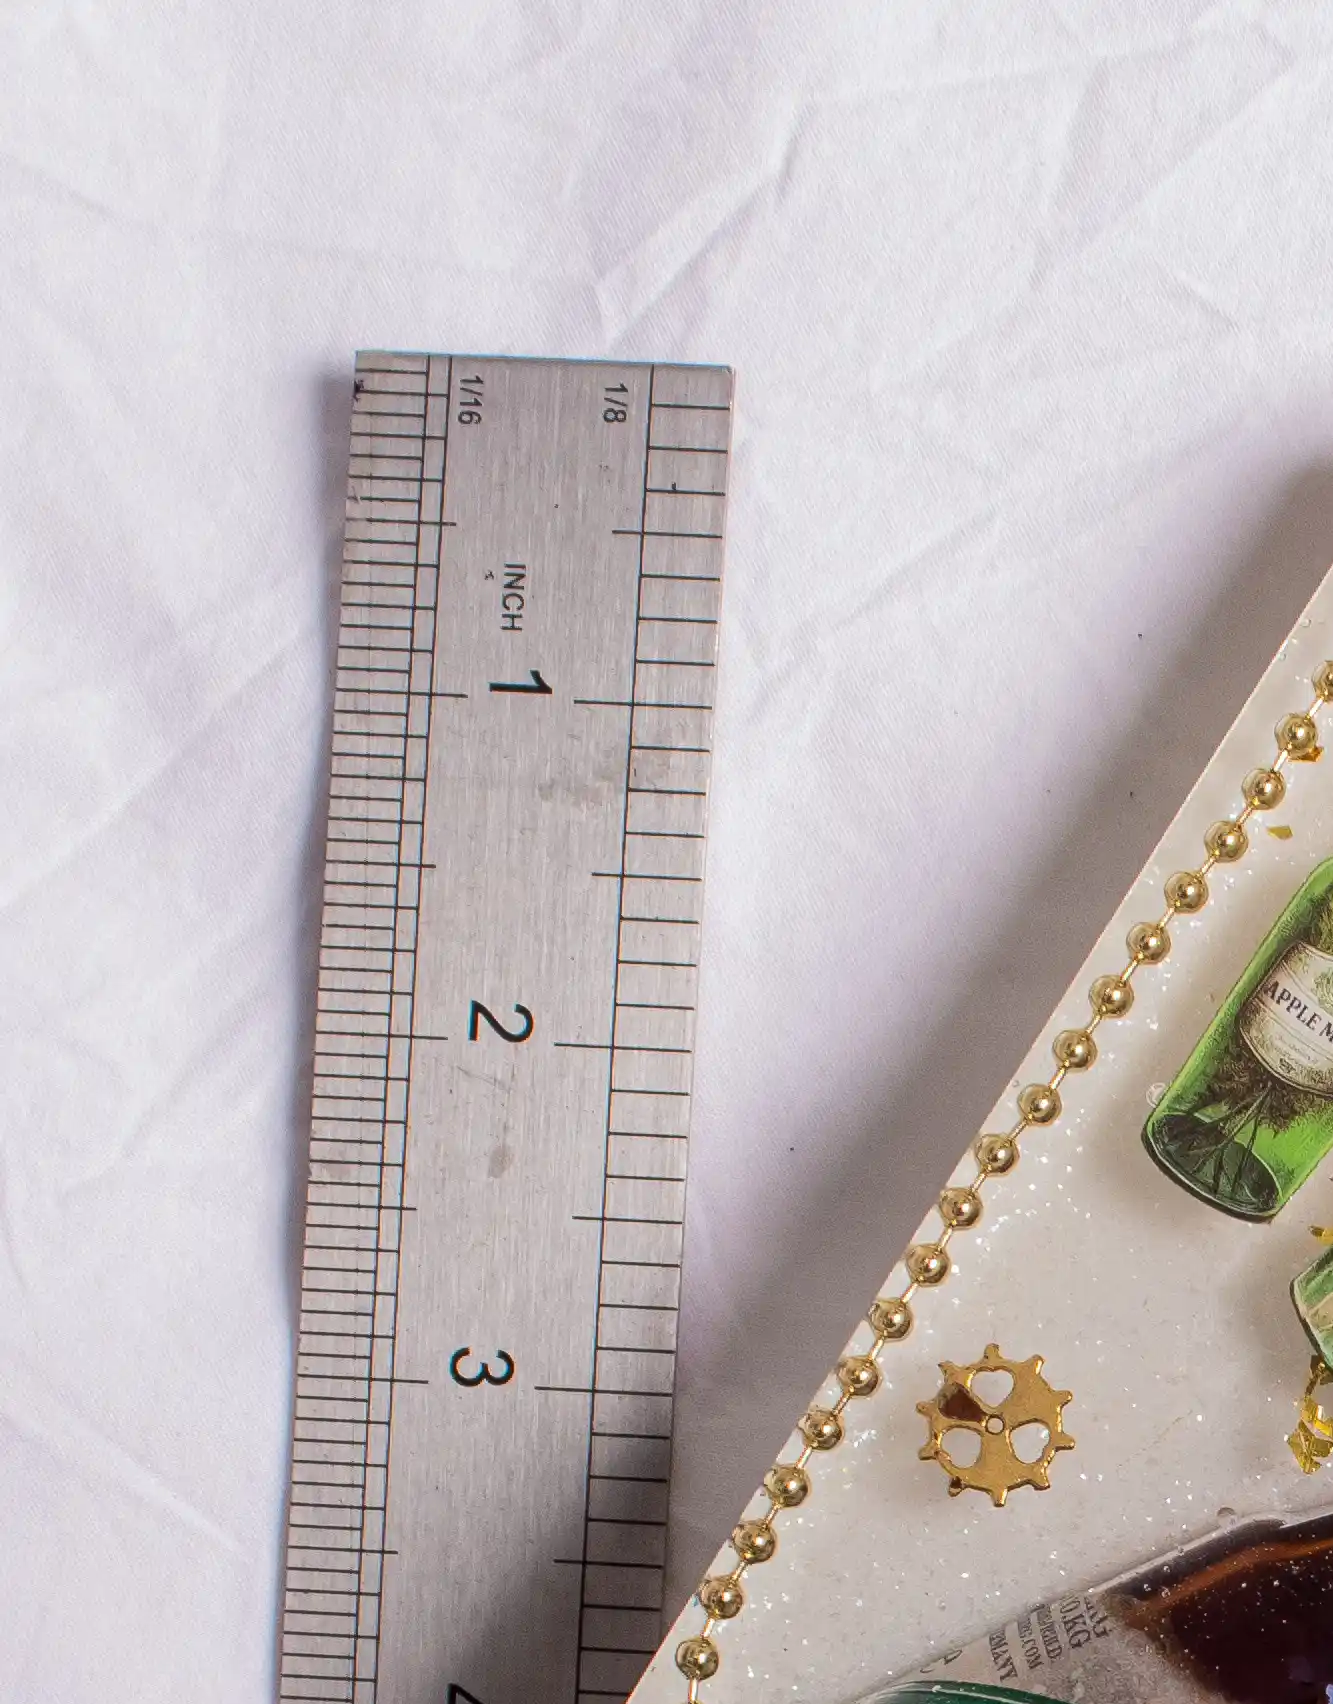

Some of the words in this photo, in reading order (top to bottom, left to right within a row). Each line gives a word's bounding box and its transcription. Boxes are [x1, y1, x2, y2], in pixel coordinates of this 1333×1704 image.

[457, 372, 485, 426] 1/16
[603, 380, 629, 425] 1/8
[501, 562, 528, 633] INCH
[489, 667, 554, 697] 1
[468, 1000, 535, 1044] 2
[1264, 980, 1322, 1031] APPLE
[450, 1347, 515, 1388] 3
